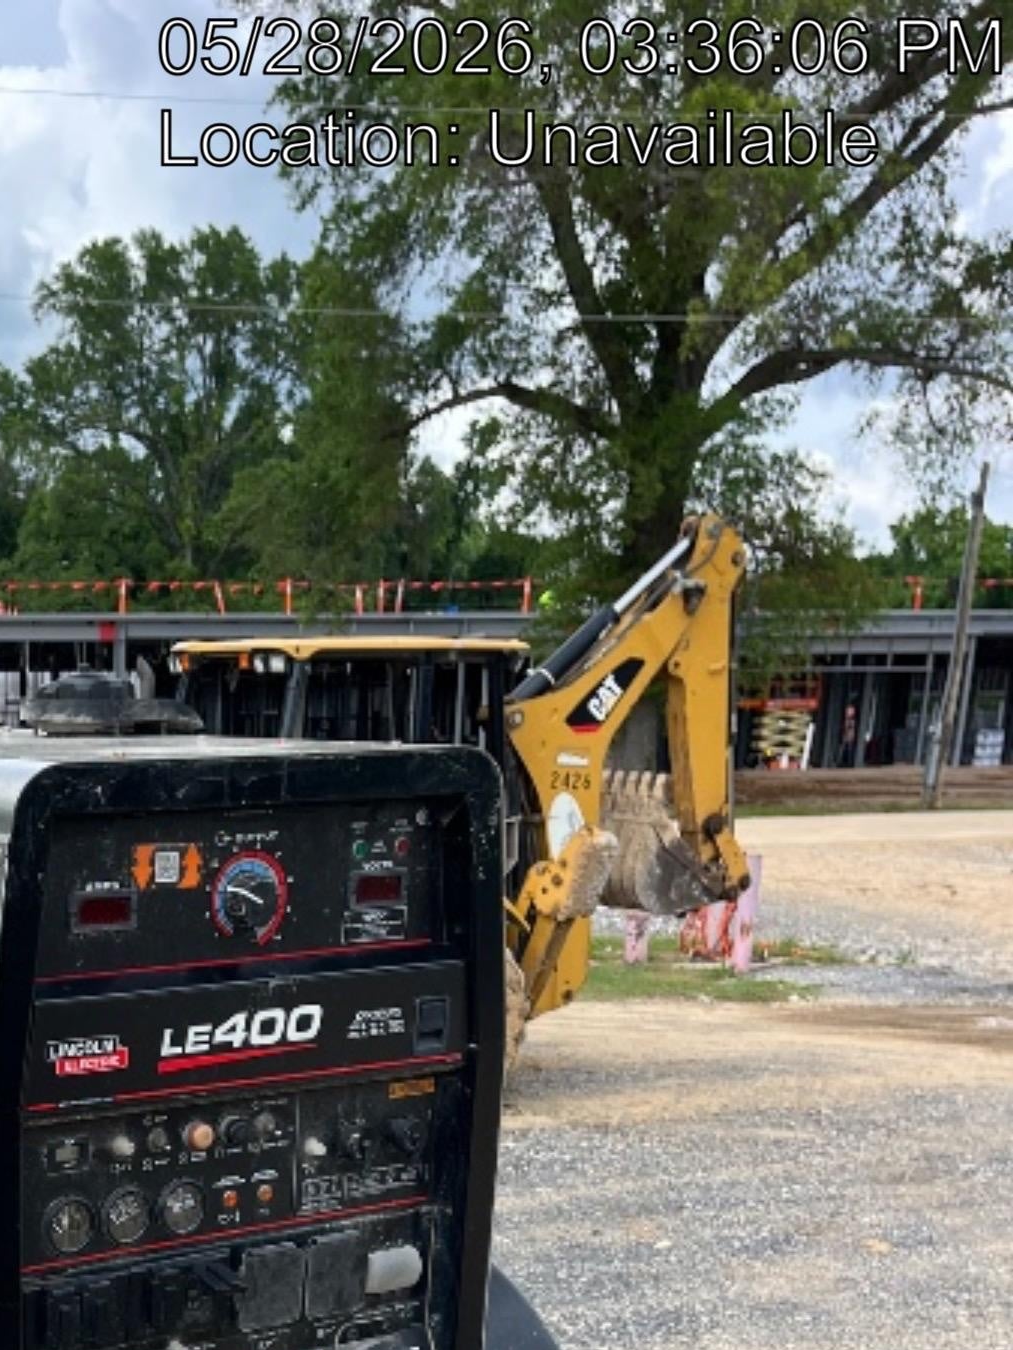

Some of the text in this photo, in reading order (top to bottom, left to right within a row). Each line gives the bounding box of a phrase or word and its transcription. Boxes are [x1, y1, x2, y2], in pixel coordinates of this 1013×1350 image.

[587, 673, 623, 721] CAT
[49, 1039, 115, 1061] LINCOLN
[160, 1004, 323, 1058] LE400
